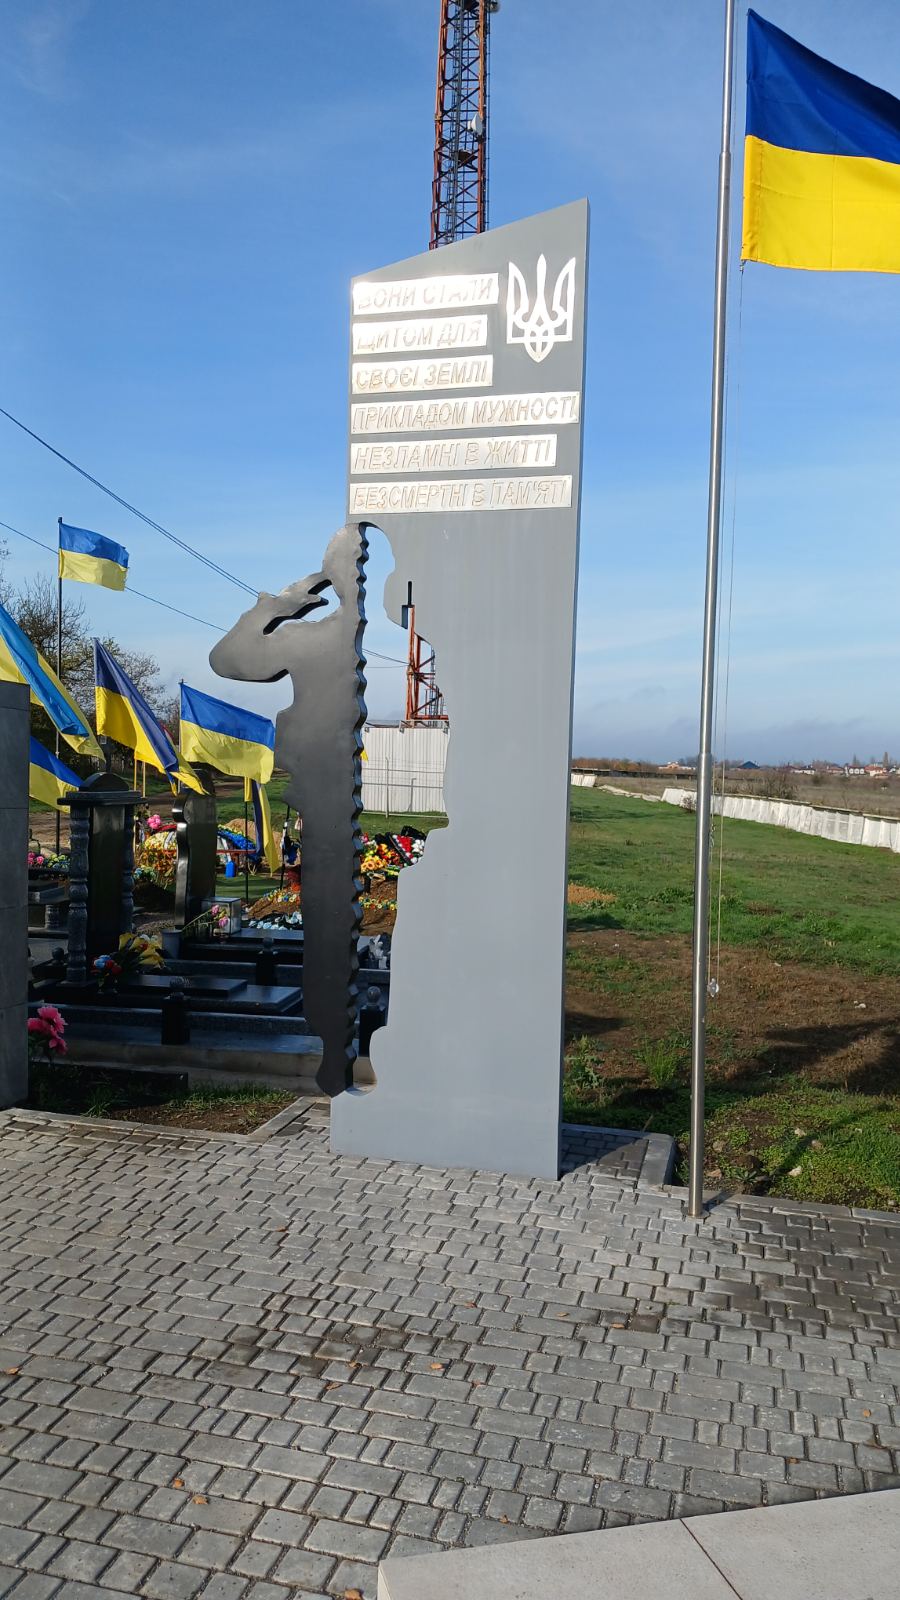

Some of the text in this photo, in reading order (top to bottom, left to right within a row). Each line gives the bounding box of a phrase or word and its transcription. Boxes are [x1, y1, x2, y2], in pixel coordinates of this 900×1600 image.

[437, 320, 482, 347] ДЛЯ
[424, 360, 487, 385] ЗЕМЛІ
[353, 396, 577, 430] ПРИКЛАДОМ МУЖНОСТІ
[355, 440, 551, 469] НЕЗЛАМНІ В ЖИТТІ
[354, 484, 468, 509] БЕЗСМЕРТНІ
[472, 483, 485, 506] В
